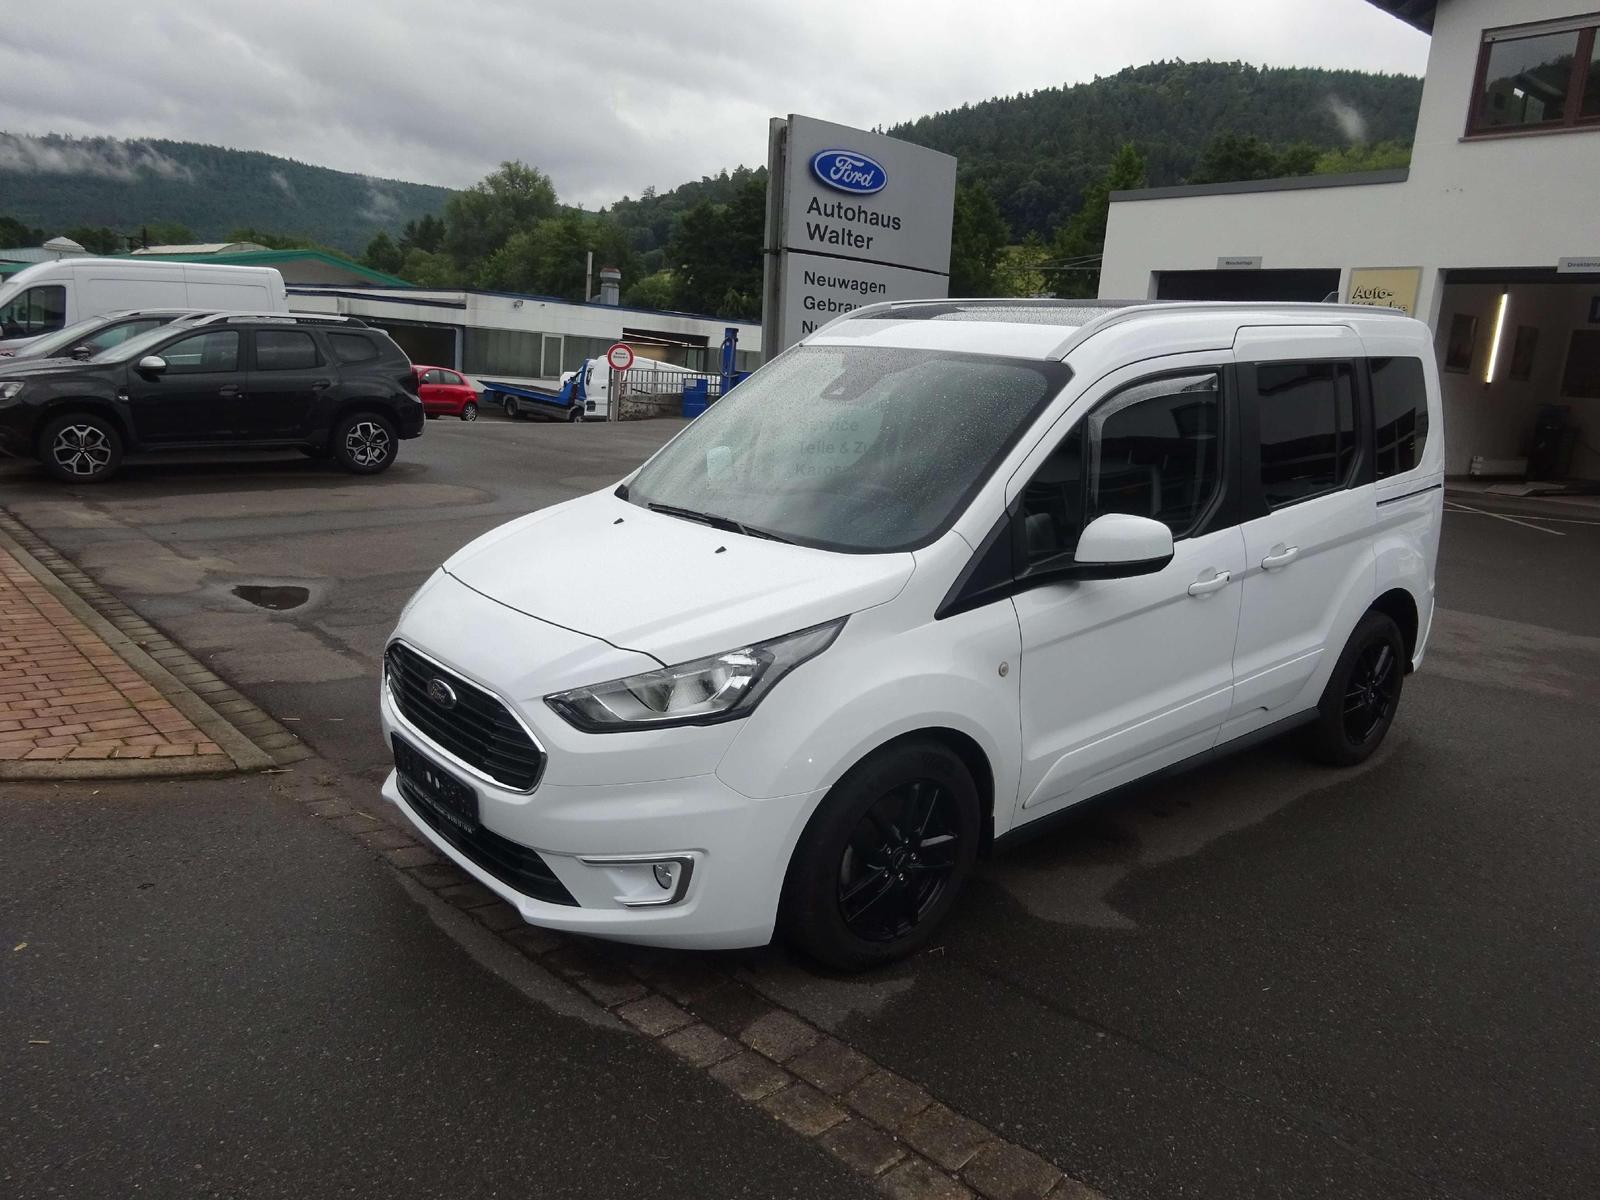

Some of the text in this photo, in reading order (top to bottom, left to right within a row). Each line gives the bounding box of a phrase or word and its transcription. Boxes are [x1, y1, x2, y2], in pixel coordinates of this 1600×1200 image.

[830, 156, 874, 188] Ford
[806, 196, 901, 230] Autohaus
[806, 222, 874, 249] Walter
[804, 270, 886, 294] Neuwagen
[1352, 286, 1393, 300] Auto-
[802, 320, 818, 334] N
